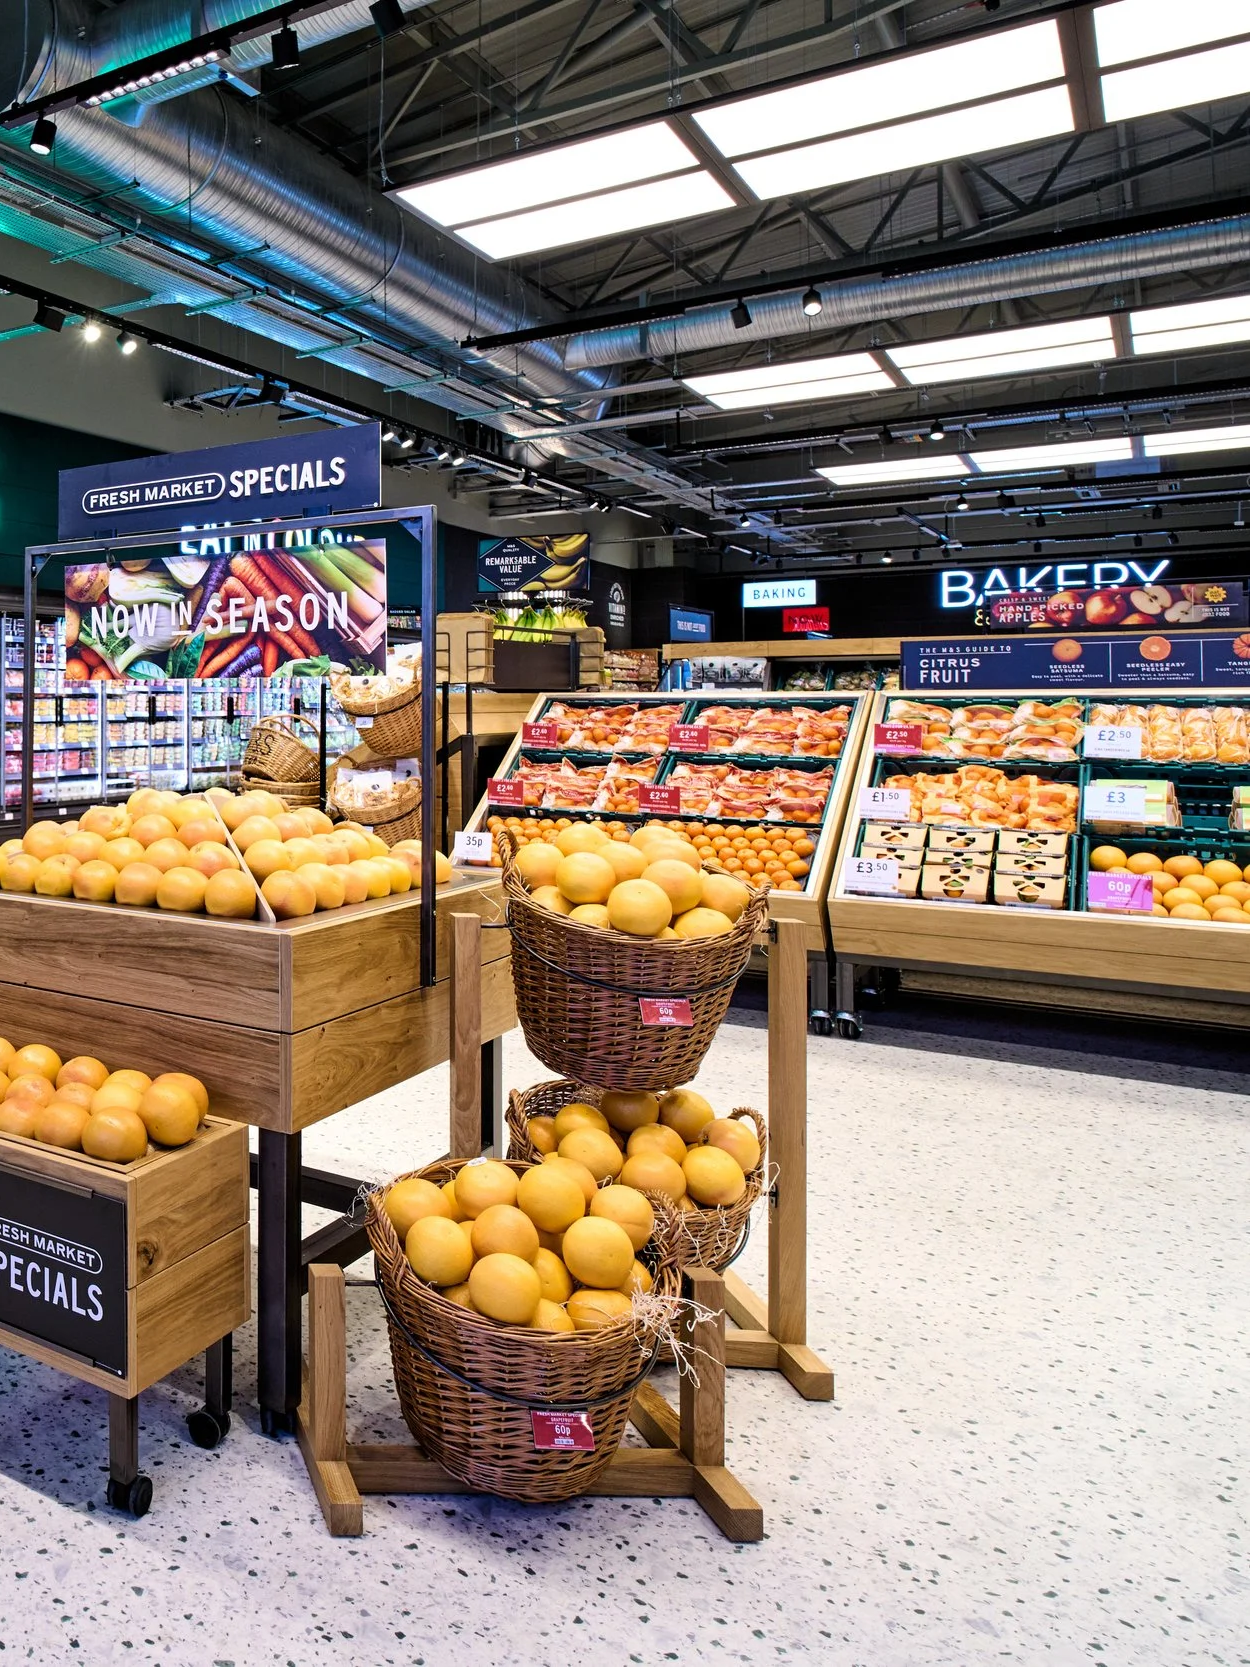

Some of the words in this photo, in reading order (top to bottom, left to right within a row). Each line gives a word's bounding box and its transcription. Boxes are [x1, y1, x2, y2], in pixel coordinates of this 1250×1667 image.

[89, 489, 140, 509] FRESH
[145, 480, 216, 502] MARKET
[229, 456, 347, 499] SPECIALS
[500, 565, 522, 573] VALUE
[753, 587, 806, 600] BAKING
[999, 603, 1084, 612] HAND-PICKED
[90, 604, 160, 640] NOW
[170, 602, 192, 627] IN
[205, 591, 350, 635] SEASON
[999, 612, 1046, 623] APPLES
[919, 658, 980, 668] CITRUS
[920, 669, 971, 684] FRUIT
[886, 731, 908, 740] £2.50
[1098, 730, 1132, 741] £2.50
[872, 792, 900, 802] £1.50
[1106, 791, 1125, 803] £3
[466, 836, 483, 848] 35p
[856, 862, 888, 873] £3.50
[1108, 880, 1131, 893] 60p
[659, 1007, 673, 1015] 60p
[34, 1233, 95, 1268] MARKET
[555, 1425, 570, 1436] 60p
